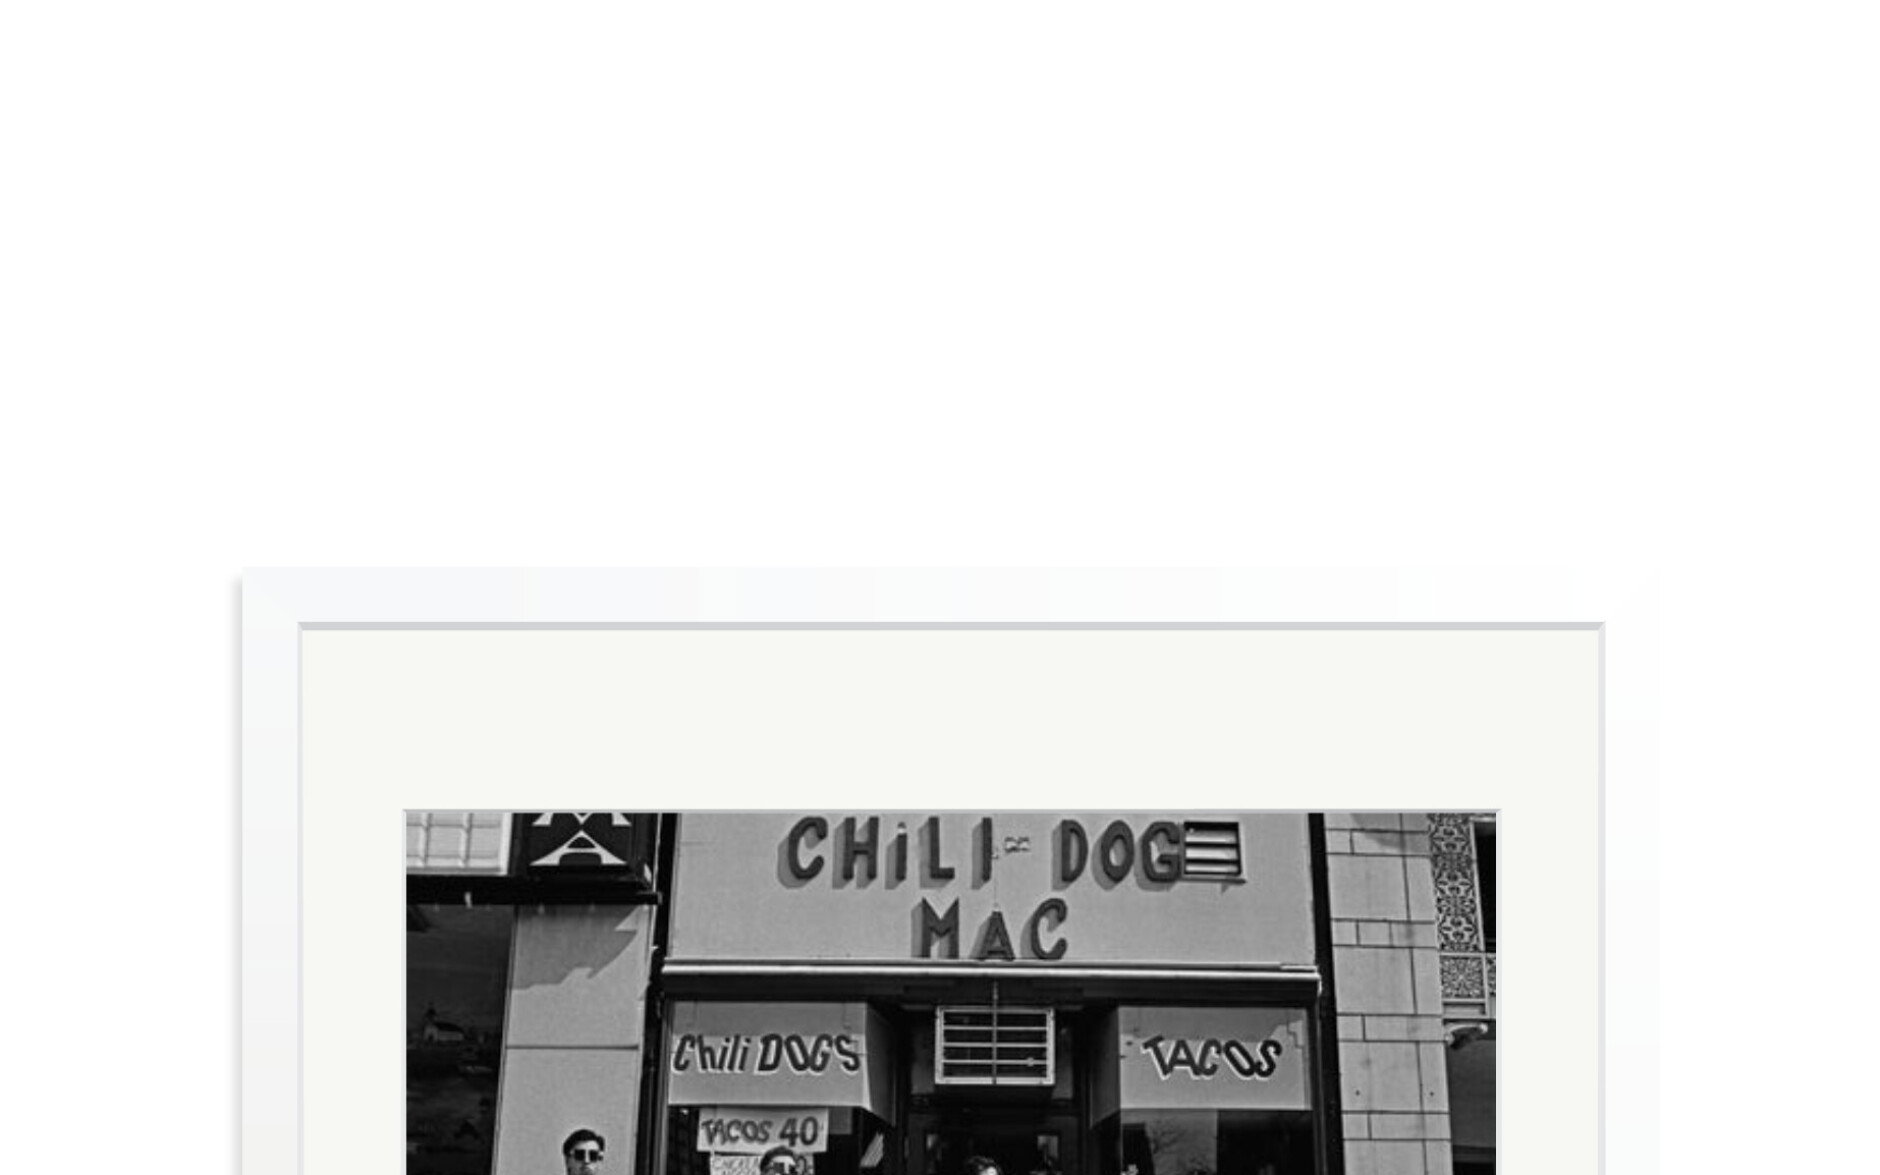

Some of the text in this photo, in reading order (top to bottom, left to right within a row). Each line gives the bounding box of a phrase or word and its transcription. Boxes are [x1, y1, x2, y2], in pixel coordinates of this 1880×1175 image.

[910, 897, 1068, 961] MAC
[671, 1033, 862, 1075] Chili DOGS
[1141, 1035, 1283, 1080] TACOS
[700, 1118, 773, 1146] TACOS
